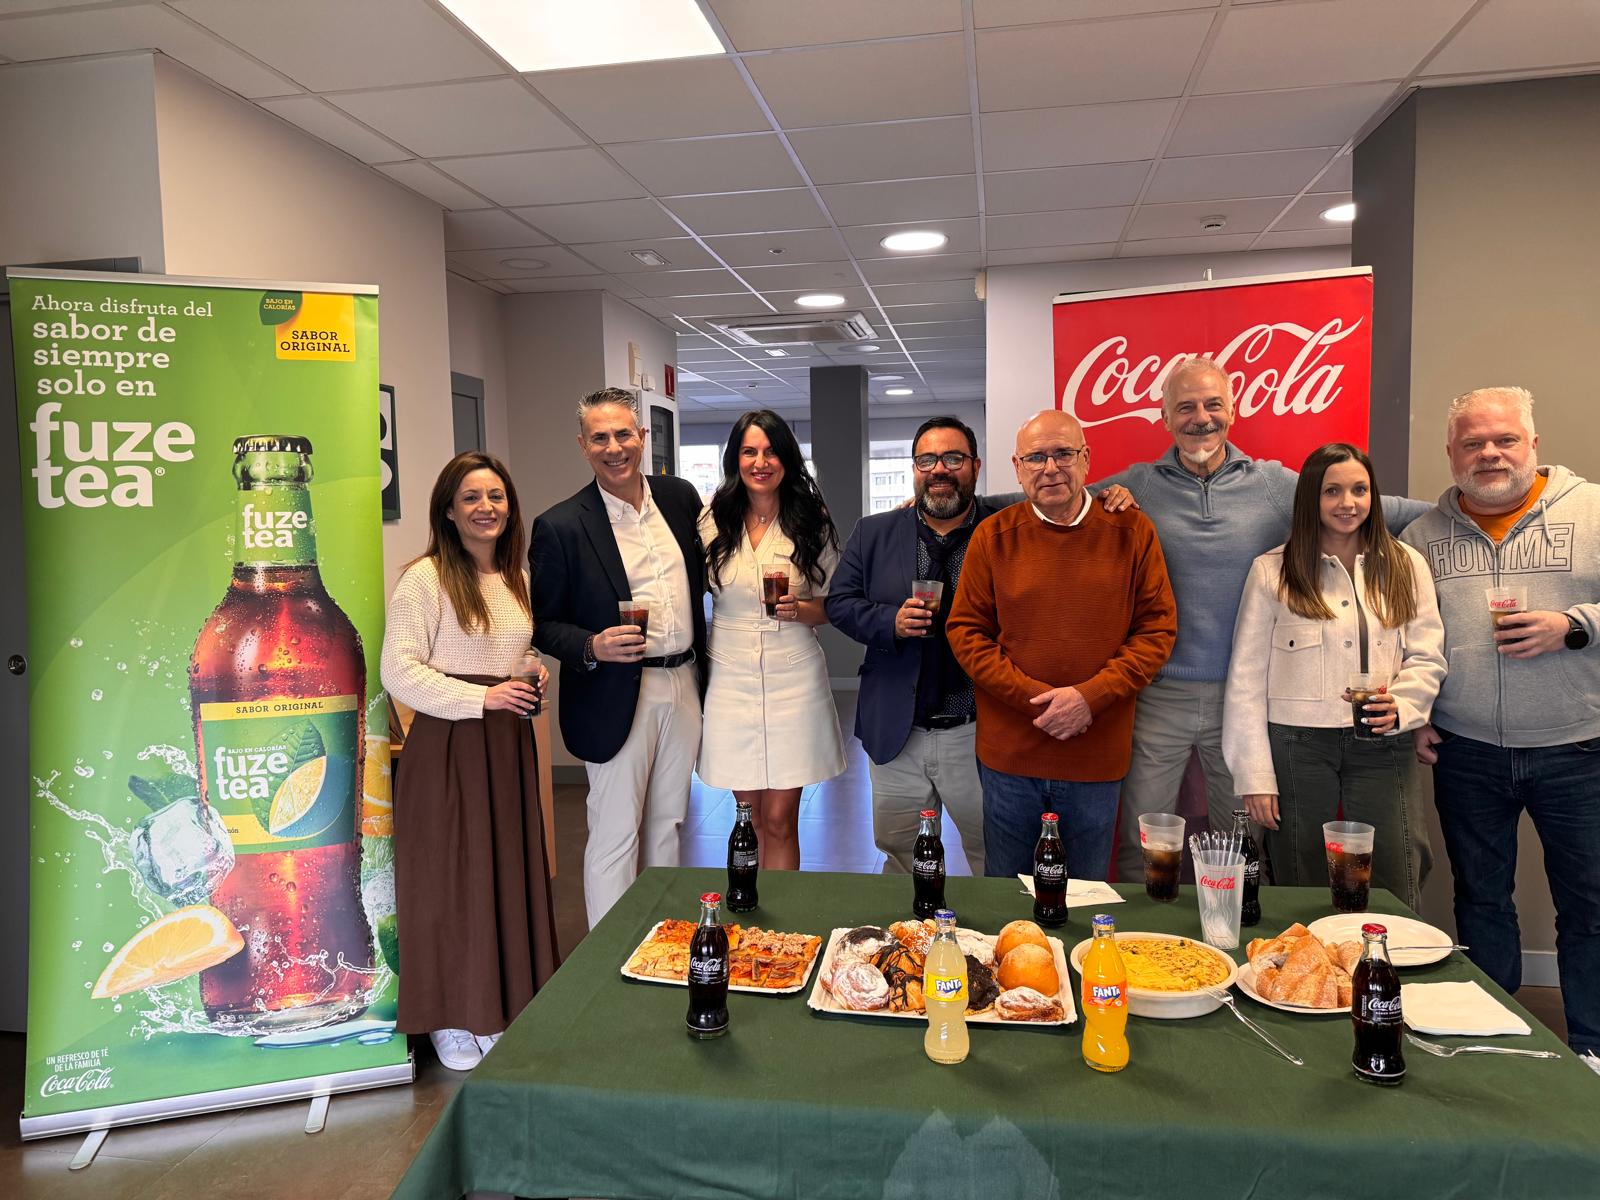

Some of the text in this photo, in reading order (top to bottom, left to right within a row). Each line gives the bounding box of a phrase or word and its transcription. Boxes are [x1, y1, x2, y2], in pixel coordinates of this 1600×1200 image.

[32, 295, 213, 317] Ahora disfruta del
[33, 313, 176, 343] sabor de
[292, 330, 339, 341] SABOR
[33, 343, 170, 374] siempre
[280, 341, 351, 353] ORIGINAL
[37, 369, 157, 397] solo en
[29, 402, 195, 463] fuze
[31, 461, 154, 509] tea
[242, 503, 308, 530] fuze
[242, 529, 294, 549] tea
[1431, 527, 1570, 578] HOMME
[236, 701, 324, 714] SABOR ORIGINAL
[214, 747, 288, 778] fuze
[216, 775, 270, 800] tea
[46, 1056, 56, 1065] UN
[57, 1051, 90, 1064] REFRESCO
[91, 1049, 100, 1058] DE
[54, 1058, 102, 1072] DE LA FAMILIA
